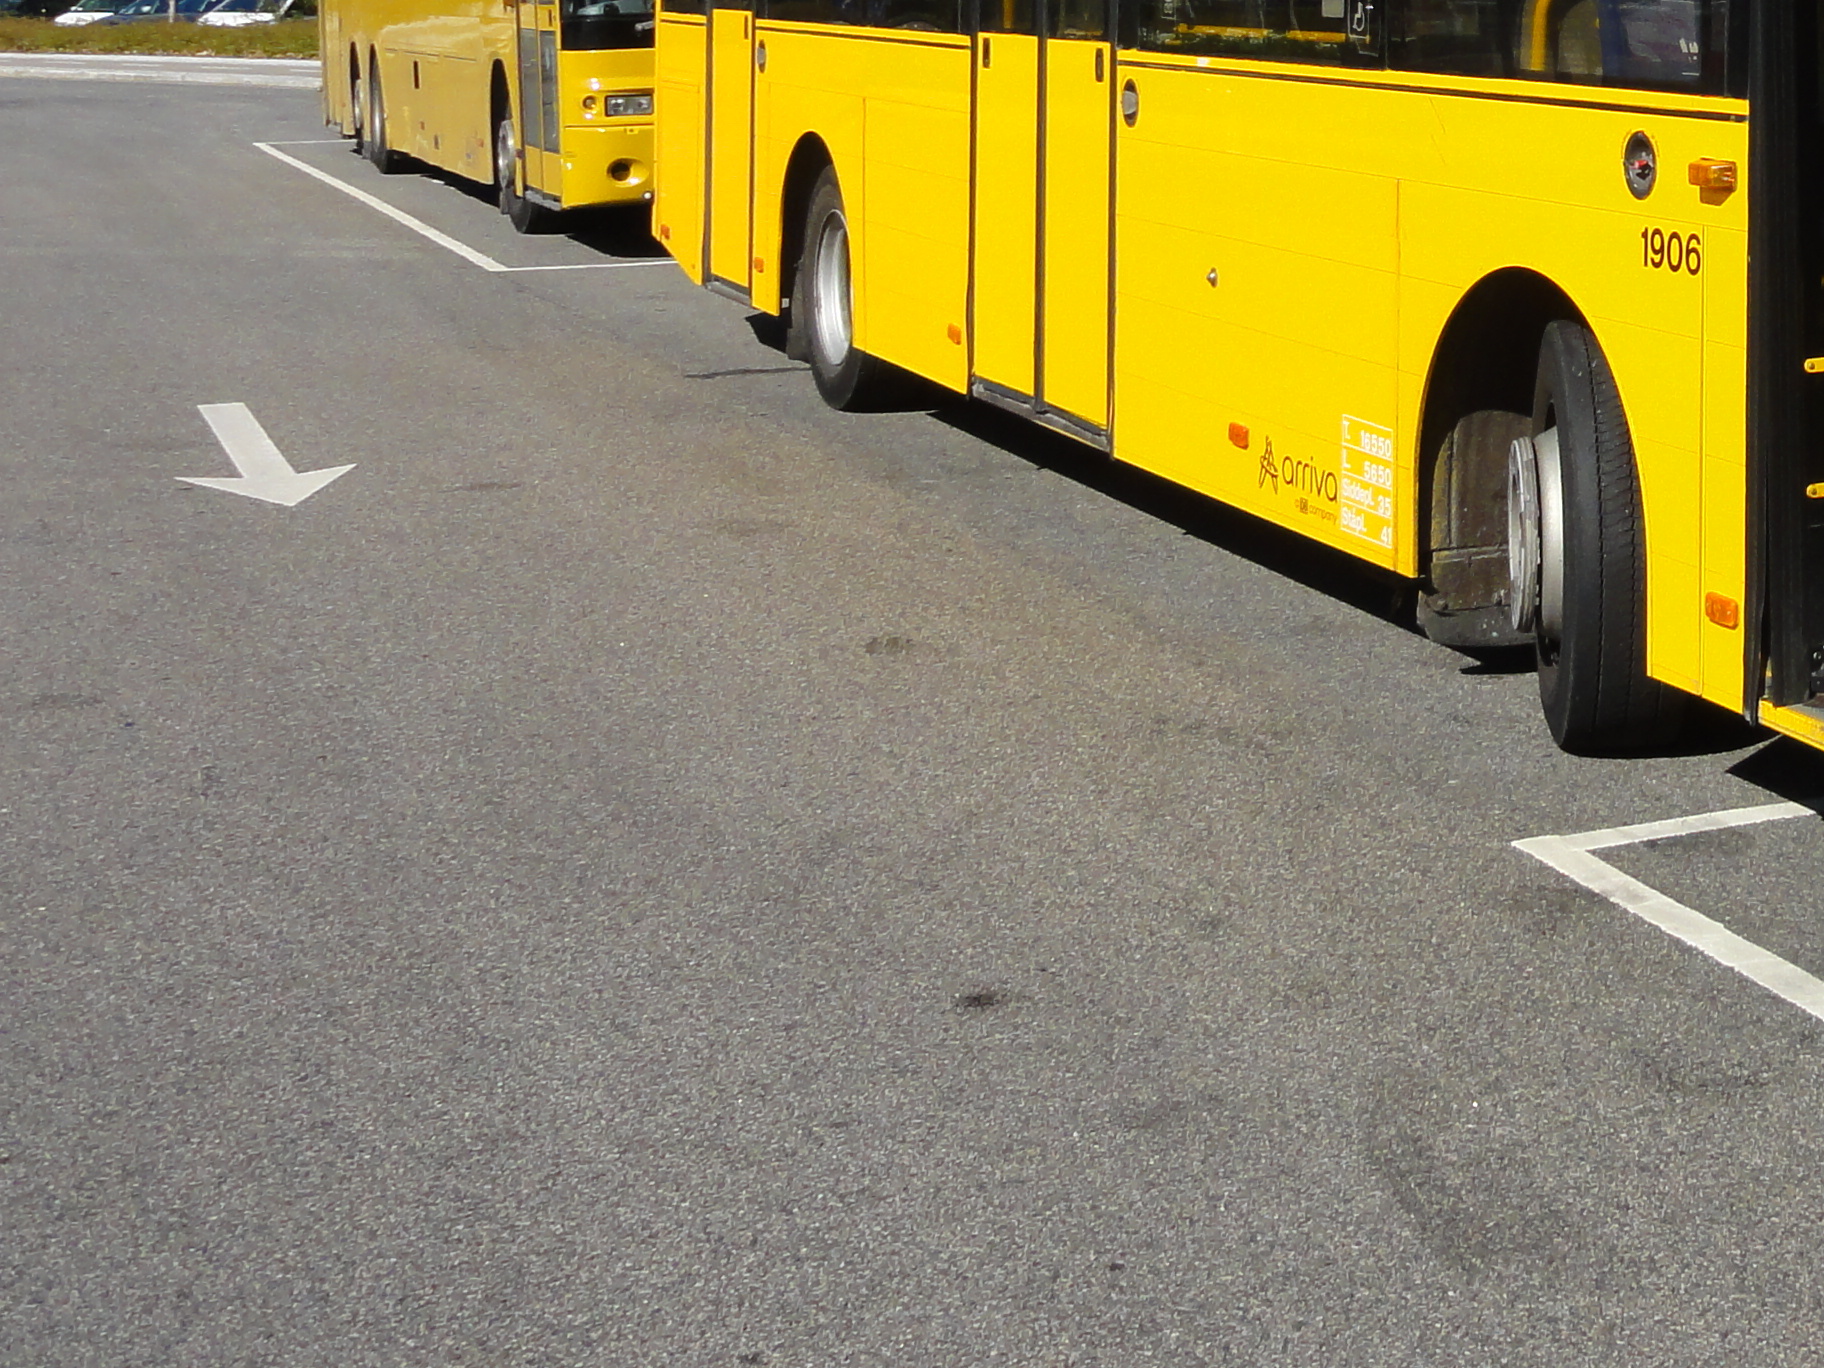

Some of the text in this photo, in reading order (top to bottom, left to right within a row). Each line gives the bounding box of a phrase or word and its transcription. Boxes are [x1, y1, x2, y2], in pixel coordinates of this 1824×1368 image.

[1641, 226, 1702, 276] 1906
[1360, 430, 1392, 457] 16550
[1282, 456, 1338, 503] arriva
[1363, 461, 1392, 486] 5650
[1377, 495, 1392, 516] 35
[1380, 526, 1392, 544] 41
